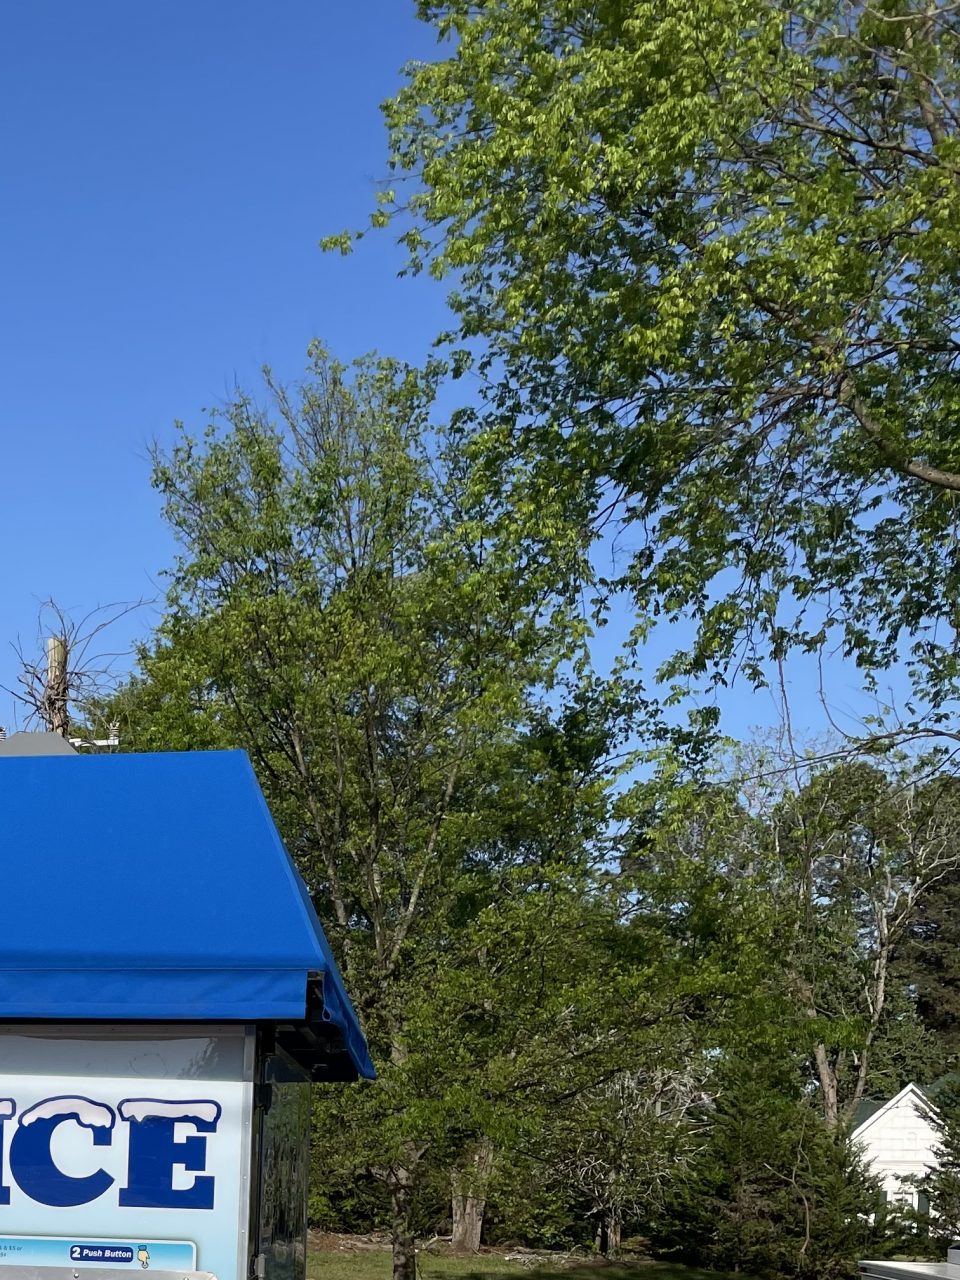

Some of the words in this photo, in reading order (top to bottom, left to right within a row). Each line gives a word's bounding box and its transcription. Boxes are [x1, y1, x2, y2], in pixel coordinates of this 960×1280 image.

[72, 1246, 81, 1258] 2
[83, 1248, 102, 1257] Push
[104, 1249, 132, 1258] Button
